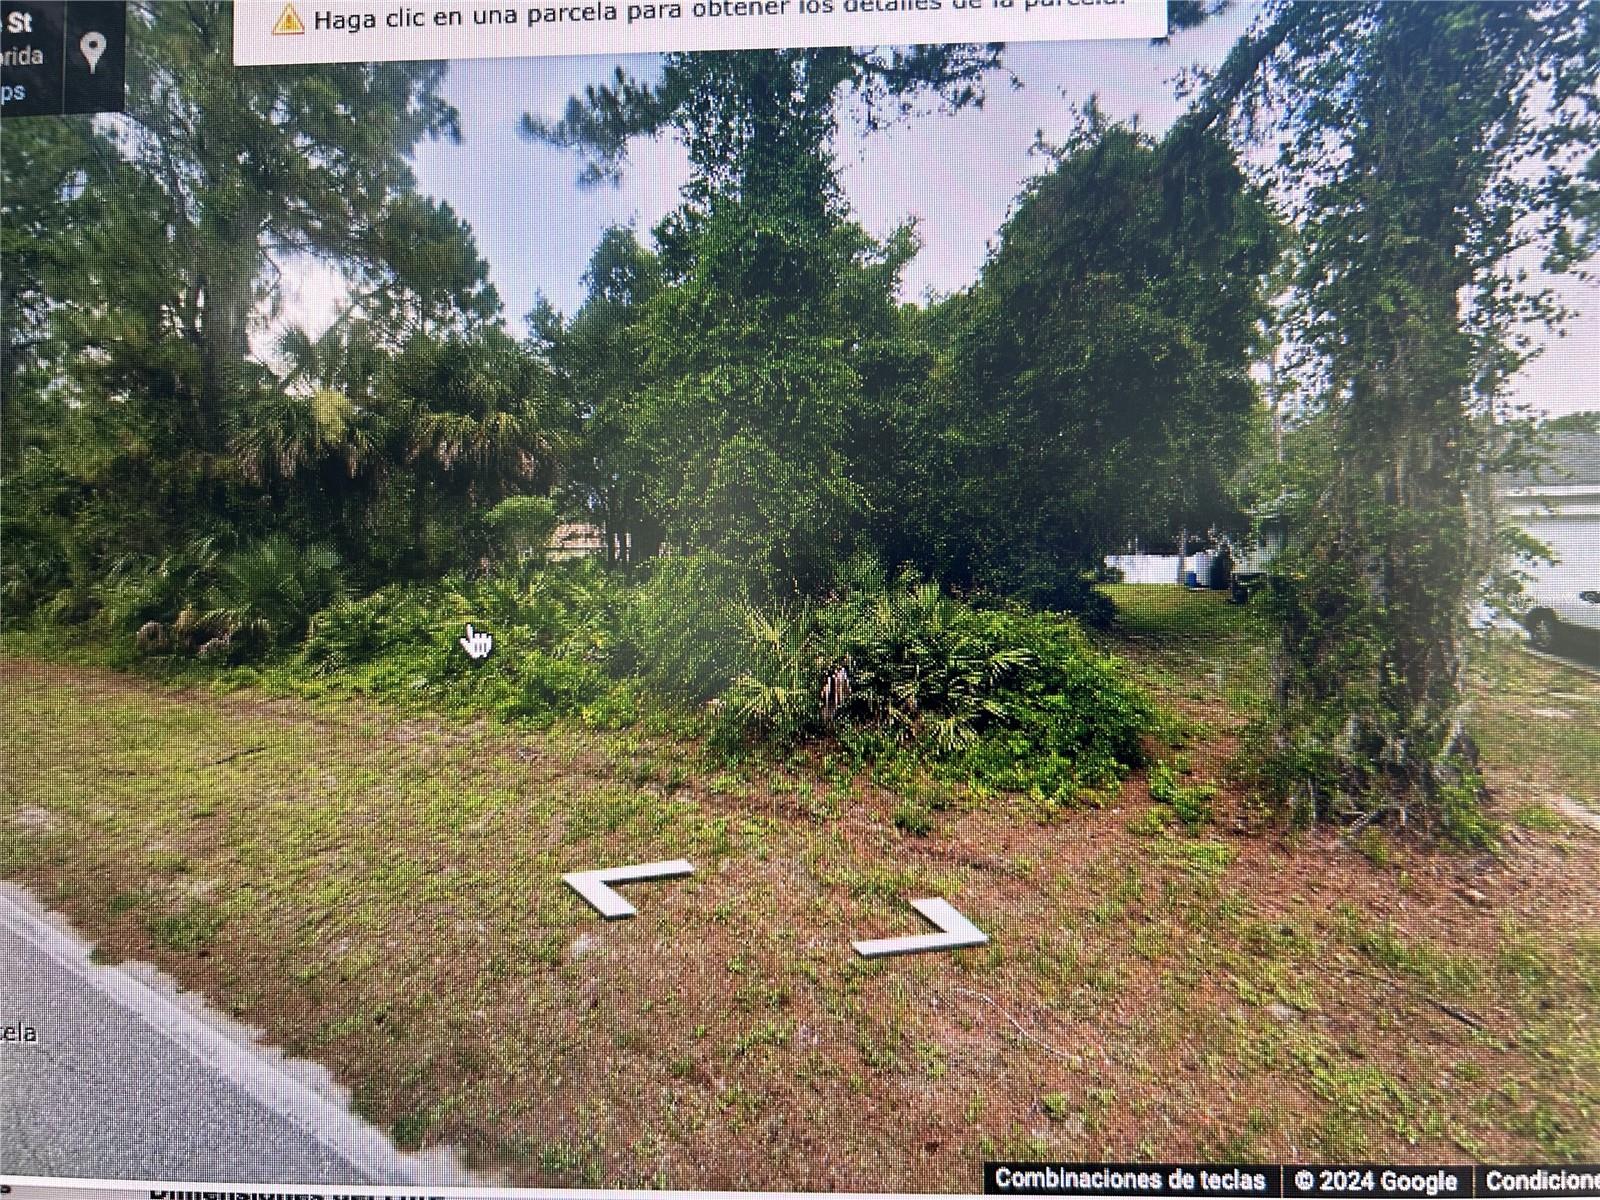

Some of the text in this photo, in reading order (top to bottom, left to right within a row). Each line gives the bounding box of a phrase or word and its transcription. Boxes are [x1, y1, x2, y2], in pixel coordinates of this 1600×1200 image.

[7, 10, 33, 34] St
[314, 10, 377, 34] Haga
[386, 7, 425, 28] clic
[433, 10, 462, 26] en
[473, 7, 518, 25] una
[527, 2, 618, 28] parcela
[627, 2, 682, 24] para
[692, 0, 788, 18] obtener
[798, 0, 834, 14] los
[0, 1021, 37, 1042] ela
[995, 1167, 1267, 1191] Combinaciones de teclas
[1295, 1169, 1458, 1195] © 2024 Google
